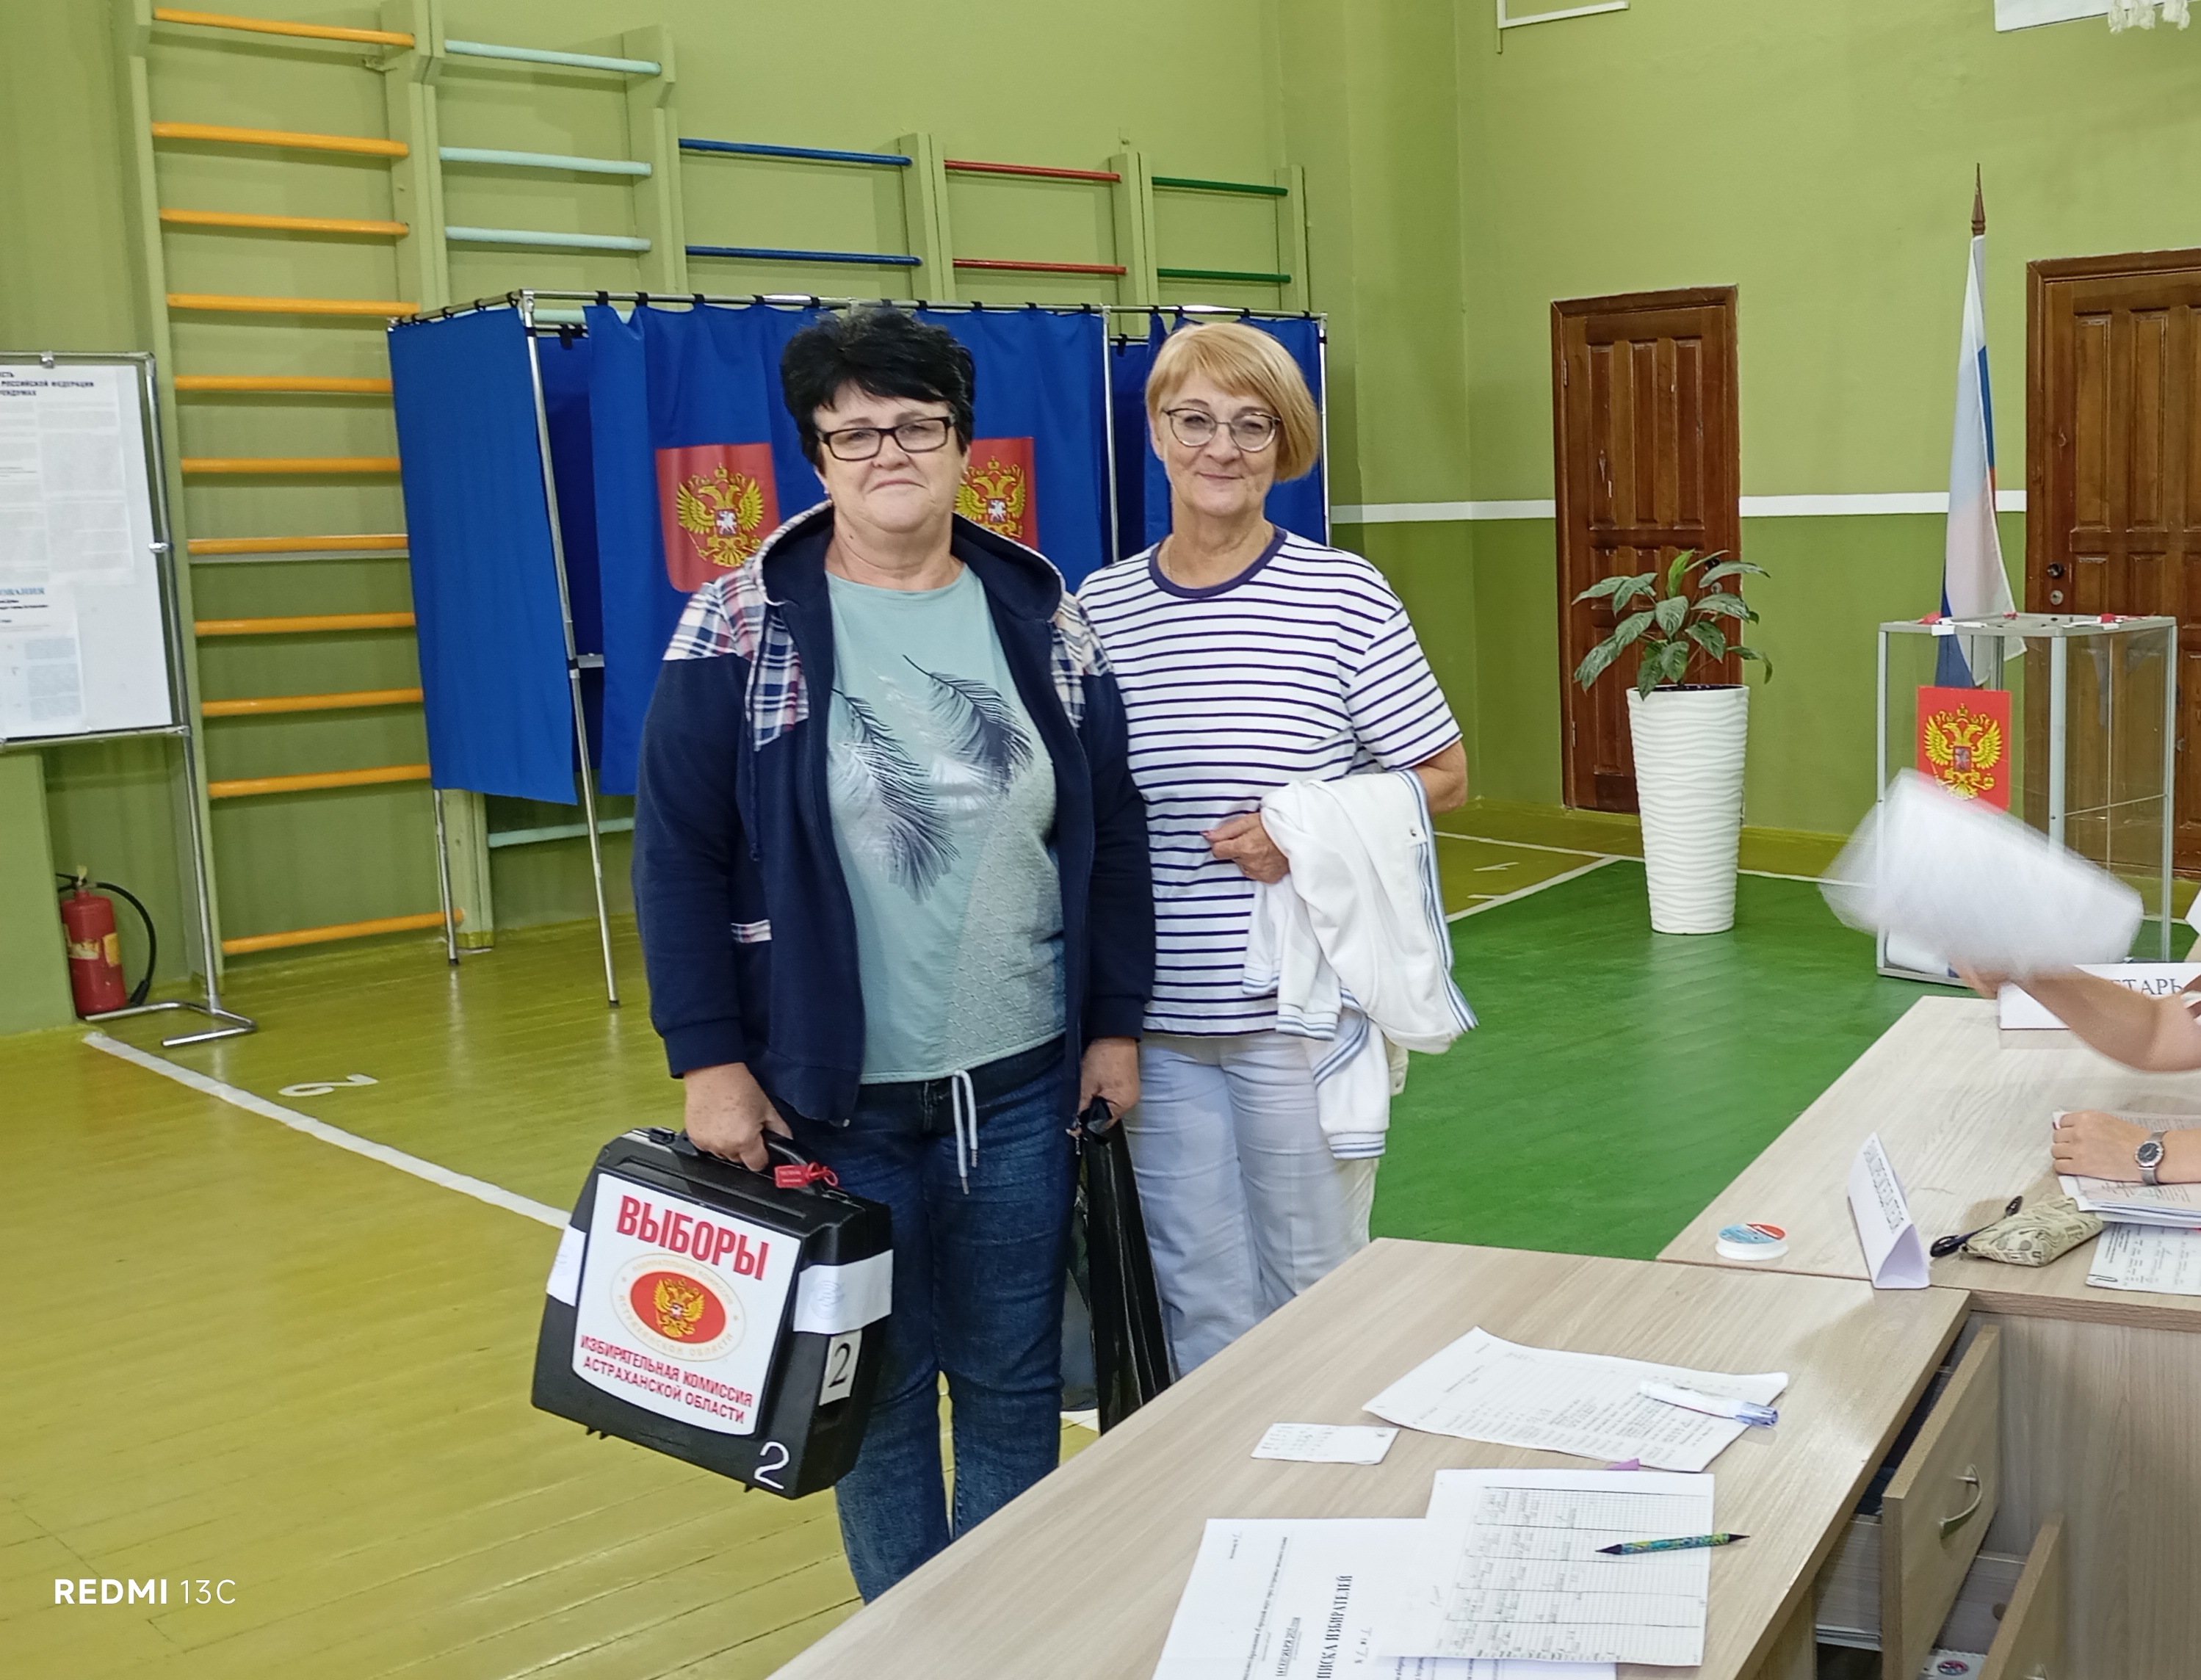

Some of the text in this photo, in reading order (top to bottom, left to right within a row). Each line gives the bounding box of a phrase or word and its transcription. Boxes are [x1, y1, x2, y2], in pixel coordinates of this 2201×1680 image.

[2111, 979, 2183, 995] ТАРЬ
[617, 1195, 769, 1281] ВЫБОРЫ
[580, 1335, 753, 1407] ИЗБИРАТЕЛЬНАЯ КОМИССИЯ
[583, 1356, 745, 1424] АСТРАХАНСКОЙ ОБЛАСТИ
[828, 1342, 851, 1388] 2
[753, 1441, 789, 1490] 2
[1324, 1575, 1353, 1640] ИЗБИРАТЕЛЕЙ
